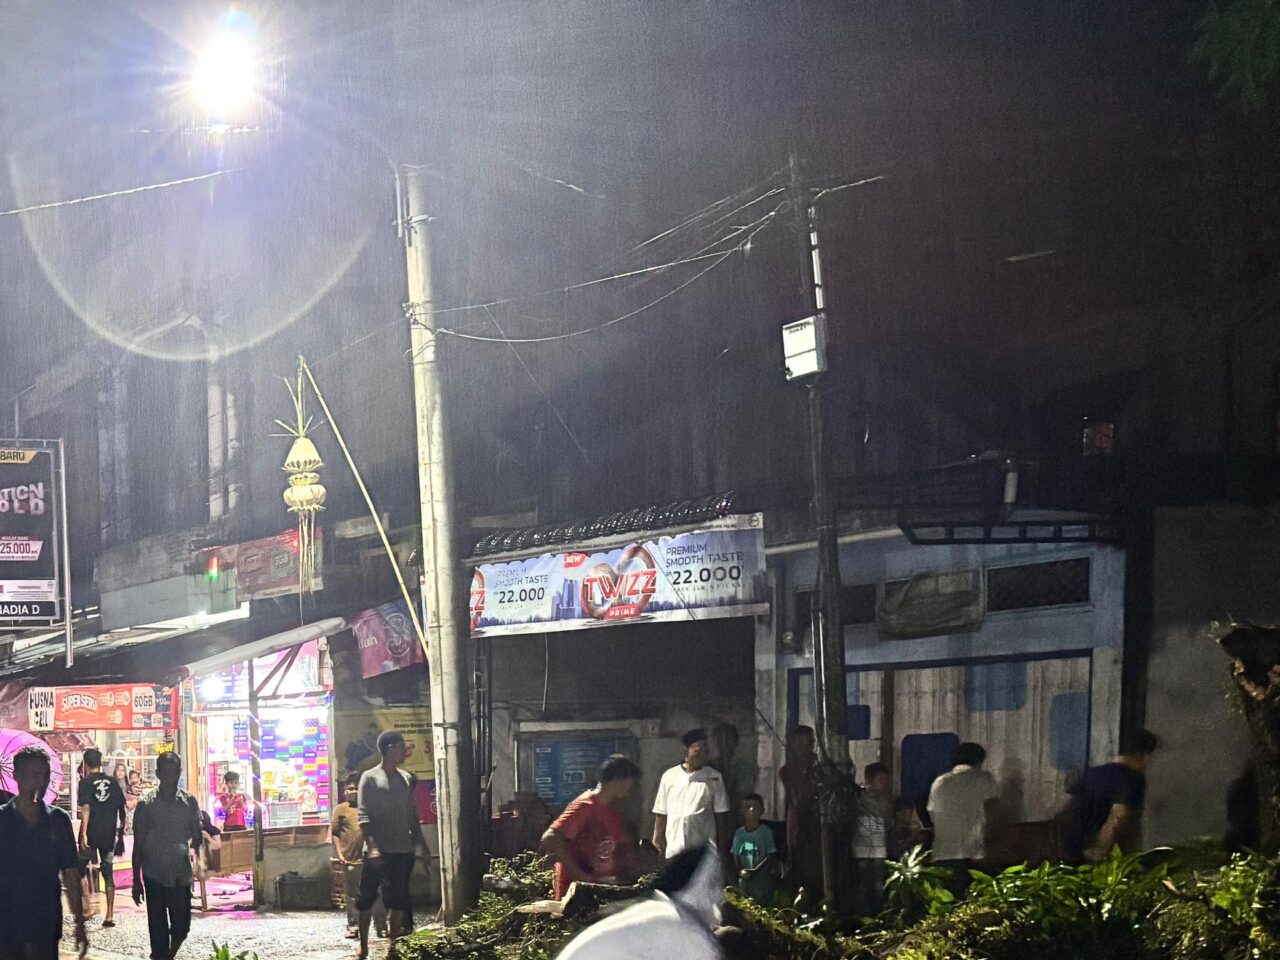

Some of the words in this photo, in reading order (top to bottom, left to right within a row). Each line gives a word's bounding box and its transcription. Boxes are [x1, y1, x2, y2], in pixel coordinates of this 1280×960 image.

[0, 451, 25, 461] BARU
[0, 542, 31, 555] 25.000
[666, 544, 707, 556] PREMIUM
[666, 557, 704, 568] SMOOTH
[708, 552, 744, 563] TASTE
[525, 574, 549, 584] TASTE
[672, 566, 742, 586] 22.000
[498, 587, 546, 604] 22.000
[32, 605, 40, 614] D
[609, 608, 635, 617] PRIME
[134, 695, 154, 708] 60GB
